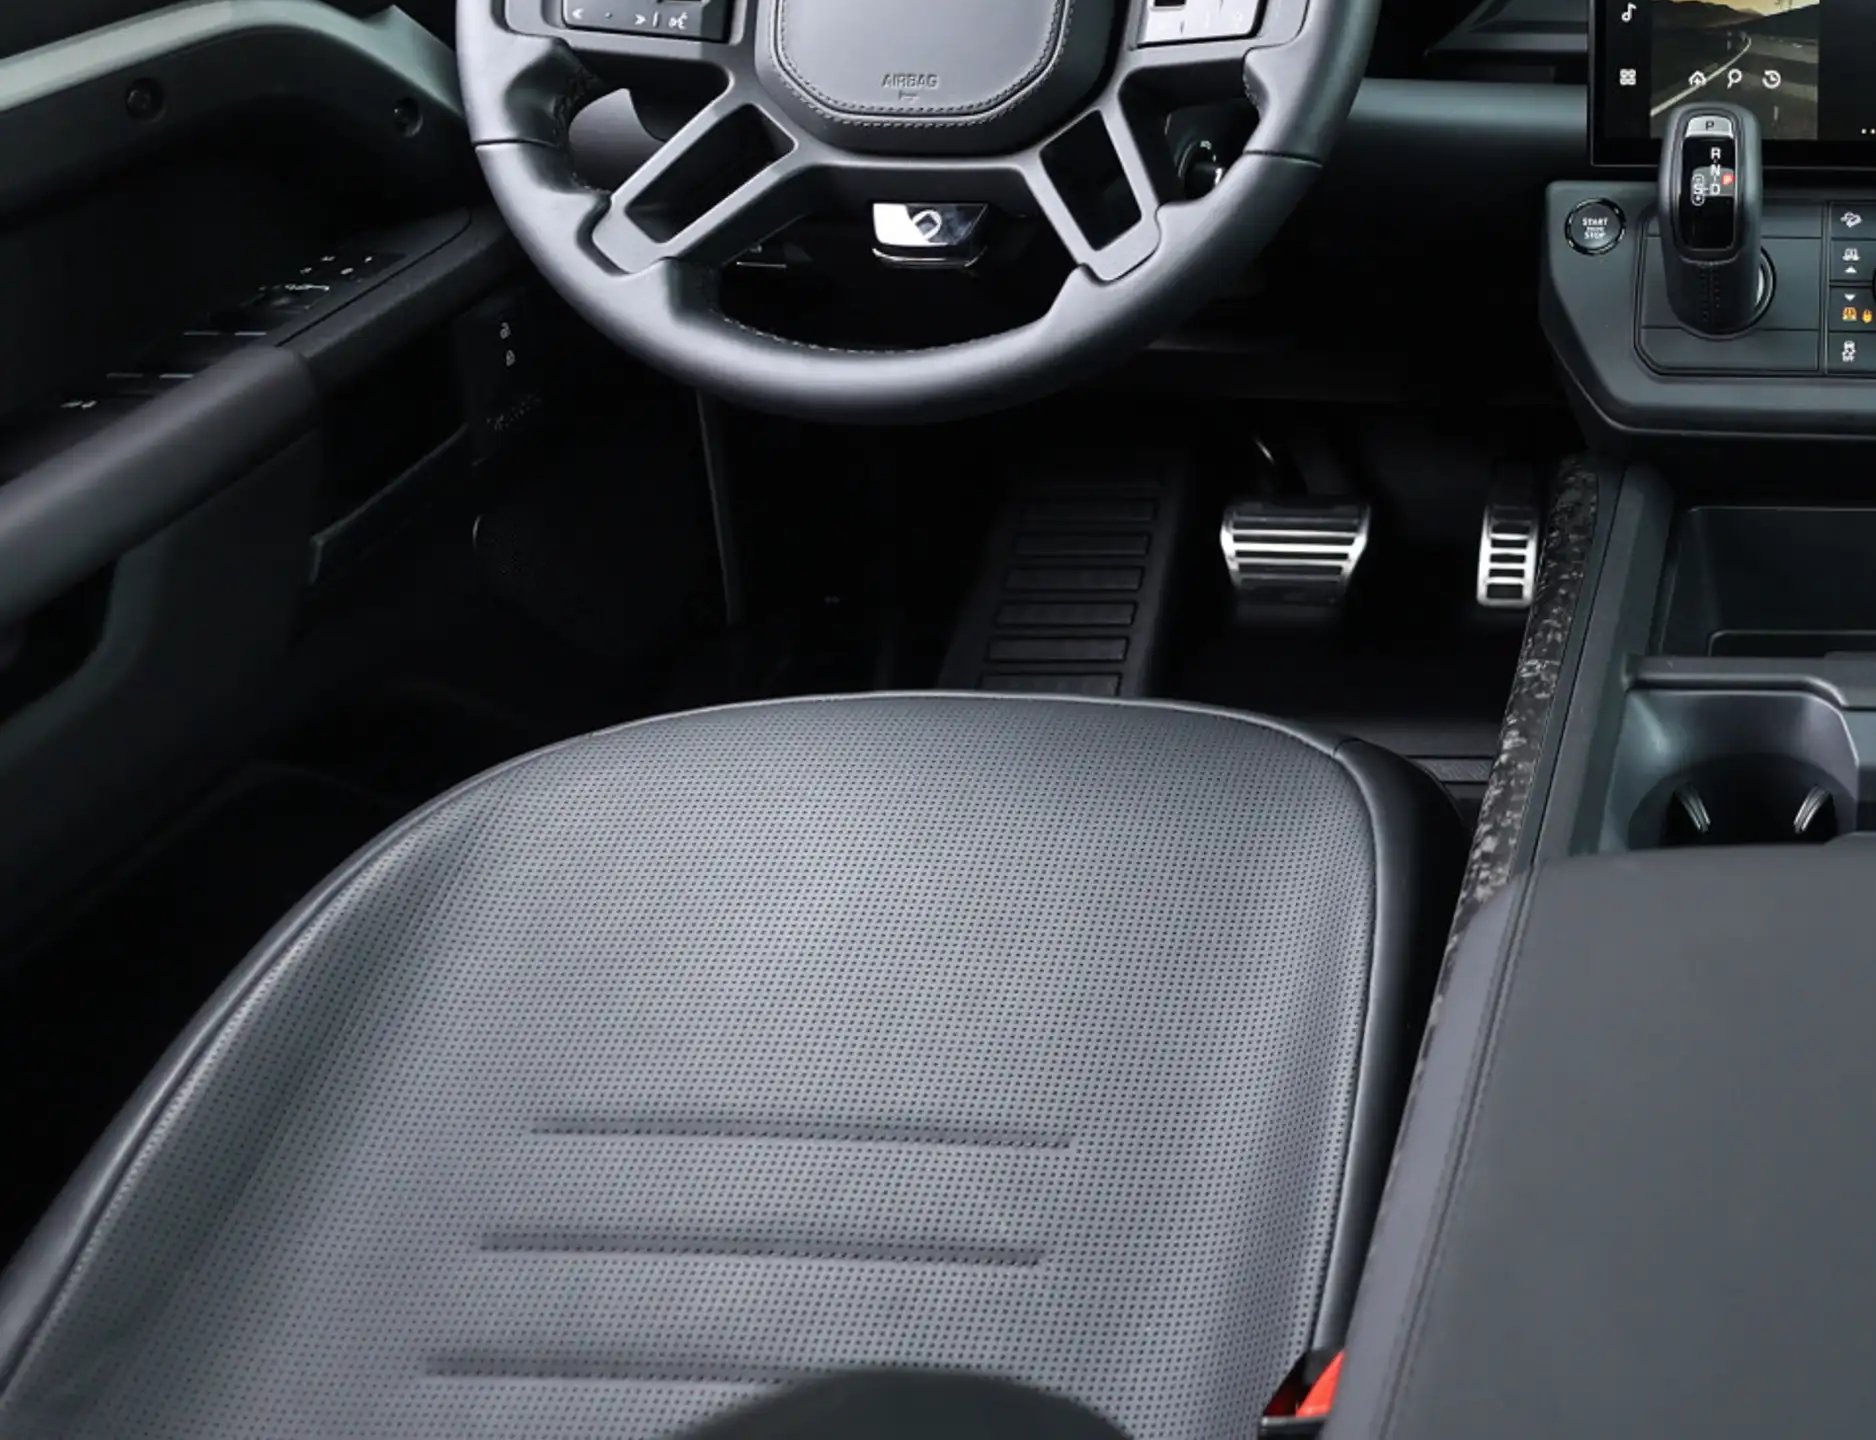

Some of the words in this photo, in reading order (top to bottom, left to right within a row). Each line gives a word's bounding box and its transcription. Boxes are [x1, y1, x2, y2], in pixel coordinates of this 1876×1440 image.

[881, 73, 938, 88] AIRBAG
[1705, 121, 1714, 131] P
[1710, 147, 1721, 160] R
[1710, 164, 1721, 176] N
[1582, 217, 1608, 226] START
[1584, 231, 1606, 240] STOP
